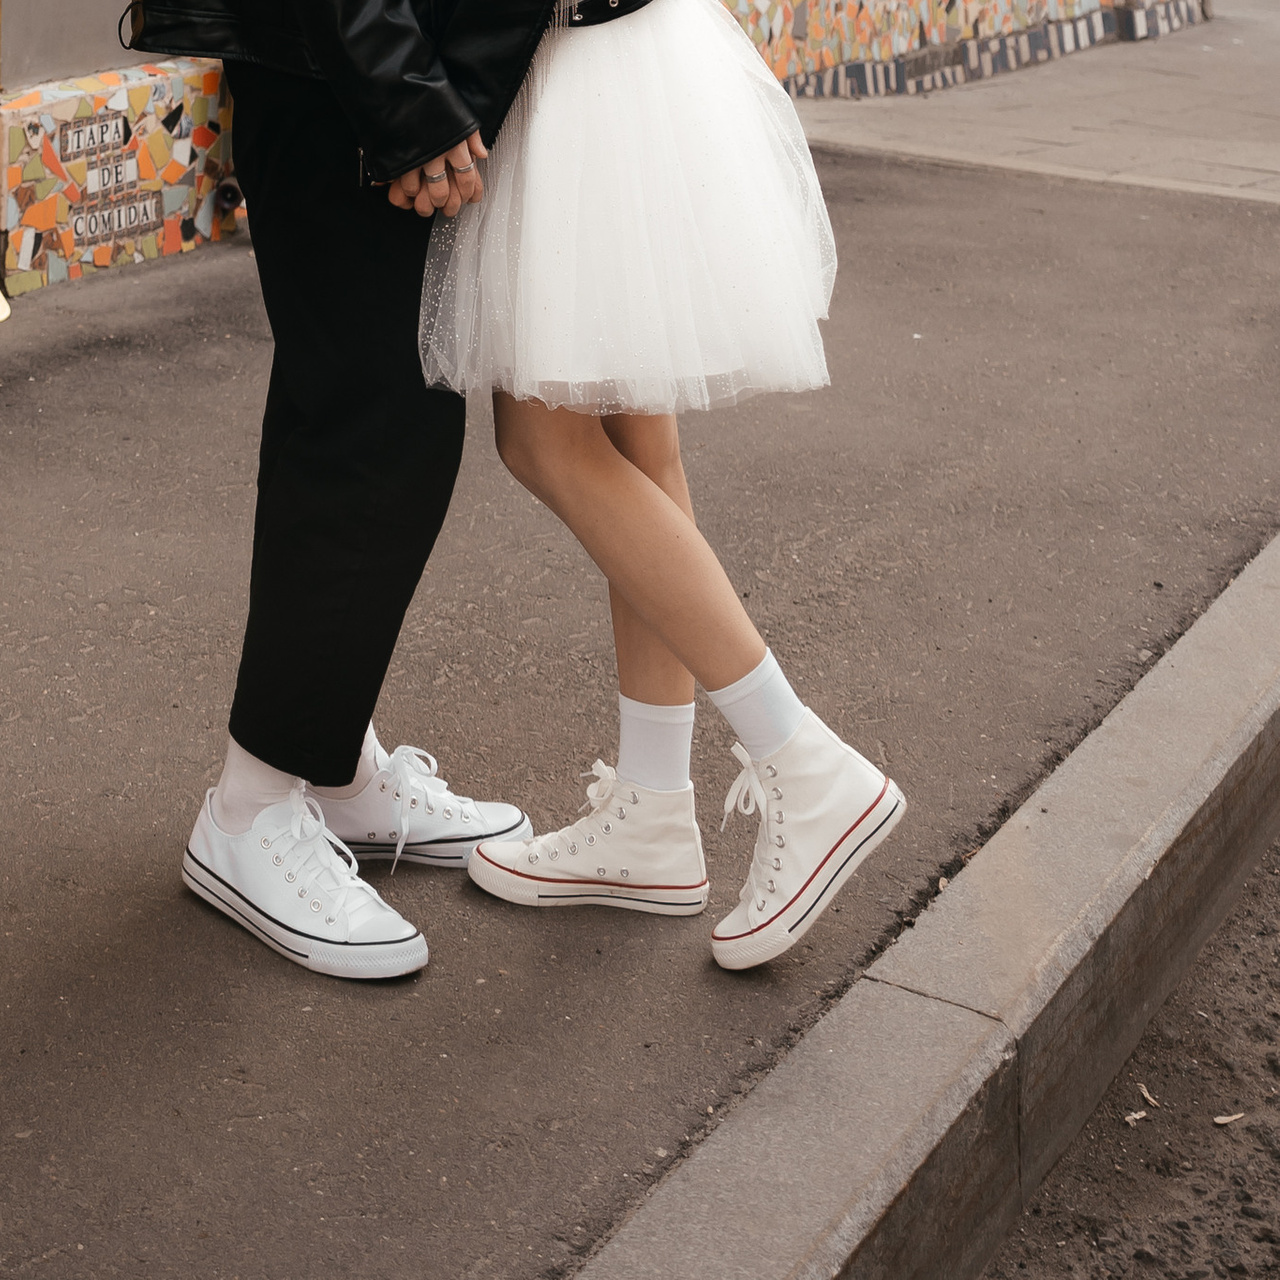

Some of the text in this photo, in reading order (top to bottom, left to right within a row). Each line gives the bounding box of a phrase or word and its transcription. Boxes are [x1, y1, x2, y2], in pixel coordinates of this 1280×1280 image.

[73, 121, 122, 149] TAPA
[101, 163, 124, 187] DE
[73, 203, 151, 236] COMIDA
